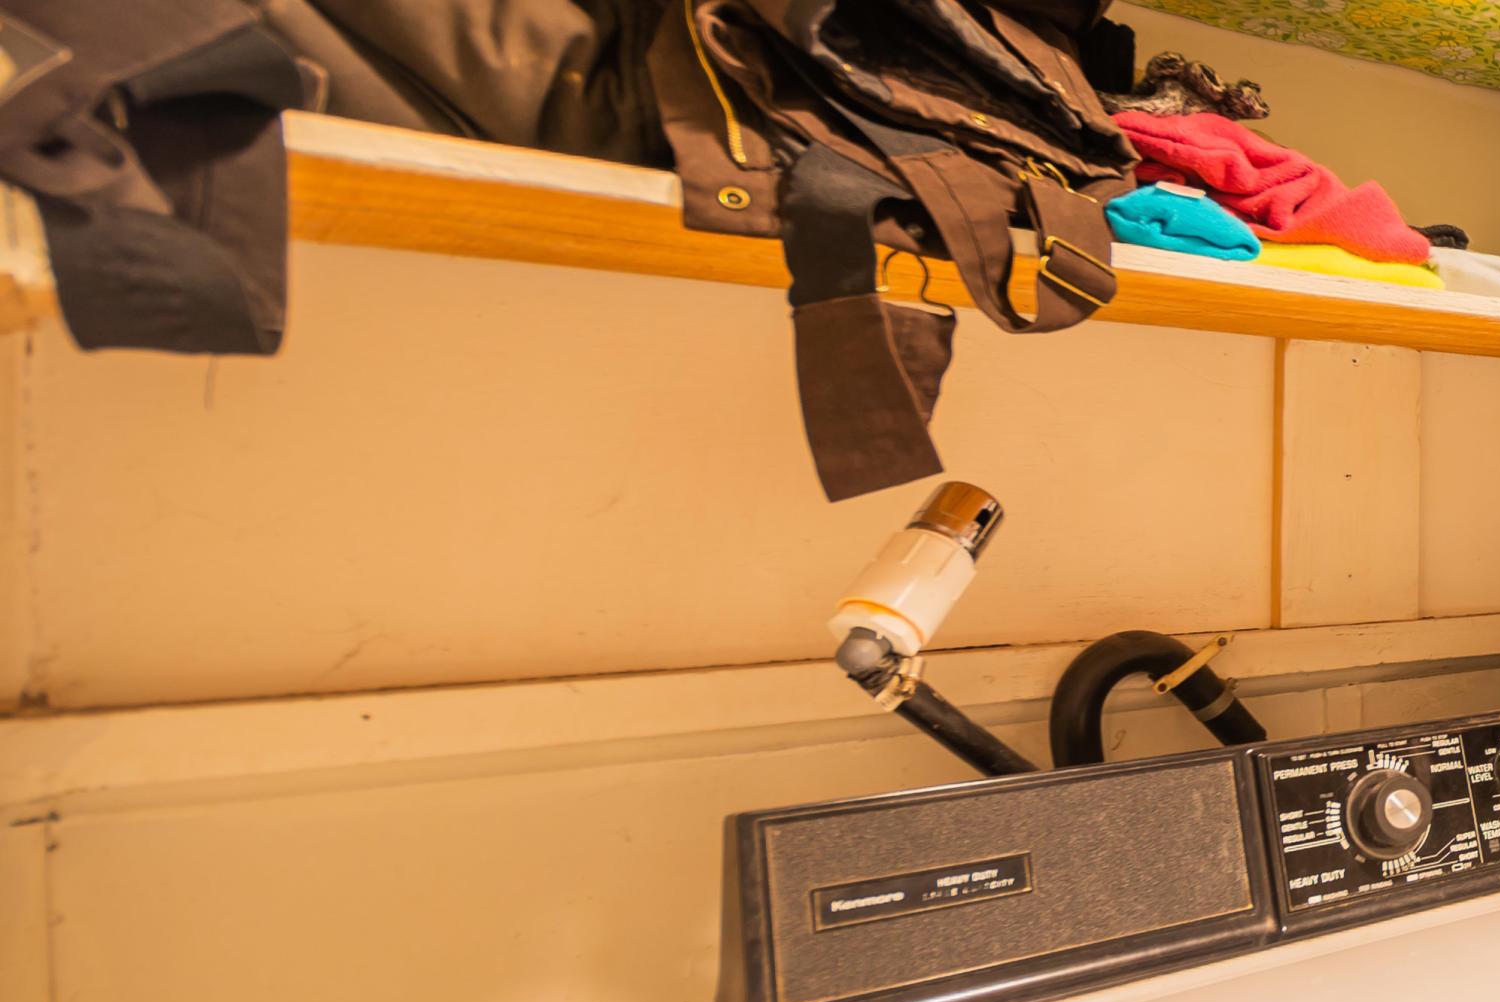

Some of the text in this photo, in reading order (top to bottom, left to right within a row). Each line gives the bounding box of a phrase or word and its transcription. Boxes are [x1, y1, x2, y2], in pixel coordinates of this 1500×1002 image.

[1273, 759, 1358, 780] PERMANENT PRESS
[1430, 760, 1464, 773] NORMAL
[1467, 762, 1494, 775] WATER
[1470, 772, 1494, 784] LEVEL
[1289, 868, 1346, 890] HEAVY DUTY
